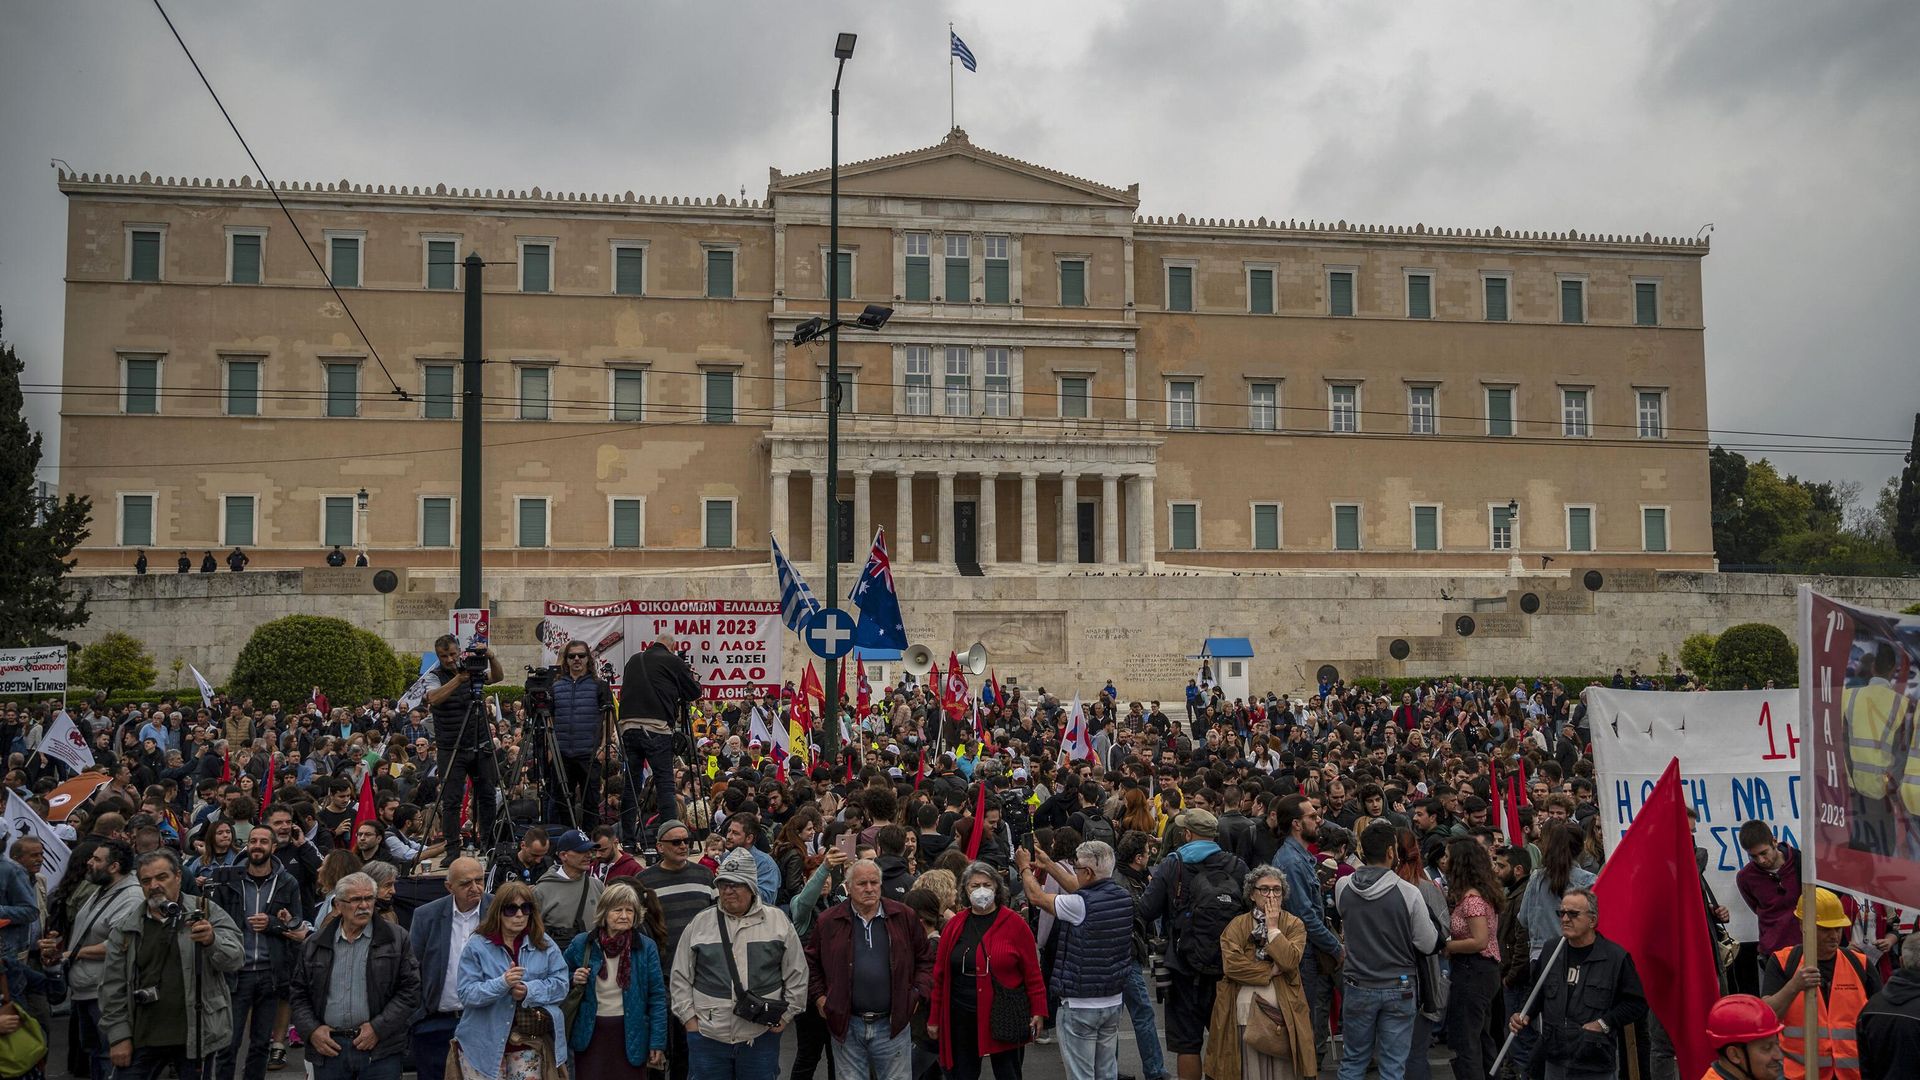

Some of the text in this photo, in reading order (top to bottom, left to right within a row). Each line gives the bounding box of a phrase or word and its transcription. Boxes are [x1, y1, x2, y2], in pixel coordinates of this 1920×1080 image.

[639, 602, 717, 613] ΟΙΚΟΔΟΜΩΝ
[723, 602, 781, 613] ΕΛΛΑΔΑΣ
[674, 619, 711, 635] ΜΑΗ
[716, 619, 757, 635] 2023
[720, 640, 767, 652] ΛΑΟΣ
[702, 655, 719, 664] ΝΑ
[726, 655, 766, 664] ΣΩΣΕΙ
[709, 667, 766, 681] ΛΑΟ
[1616, 779, 1634, 824] Η
[1732, 777, 1774, 822] ΝΑ
[1820, 802, 1846, 828] 2023
